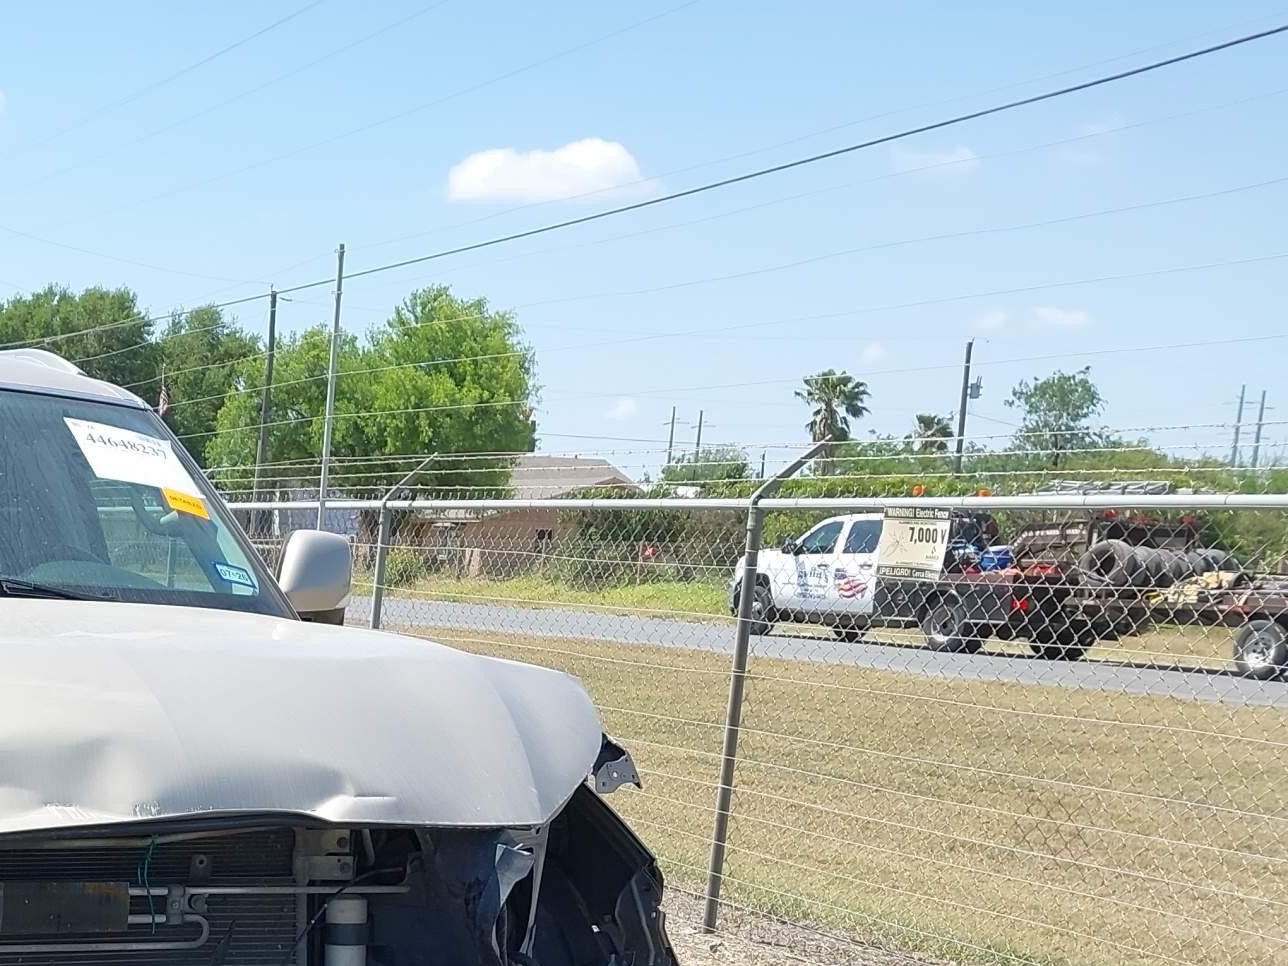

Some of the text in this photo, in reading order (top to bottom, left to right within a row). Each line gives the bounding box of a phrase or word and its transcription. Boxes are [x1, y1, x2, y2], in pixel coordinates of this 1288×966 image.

[86, 433, 167, 460] 44648237
[887, 507, 915, 518] WARNING!
[915, 508, 934, 518] Electric
[909, 526, 938, 544] 7,000
